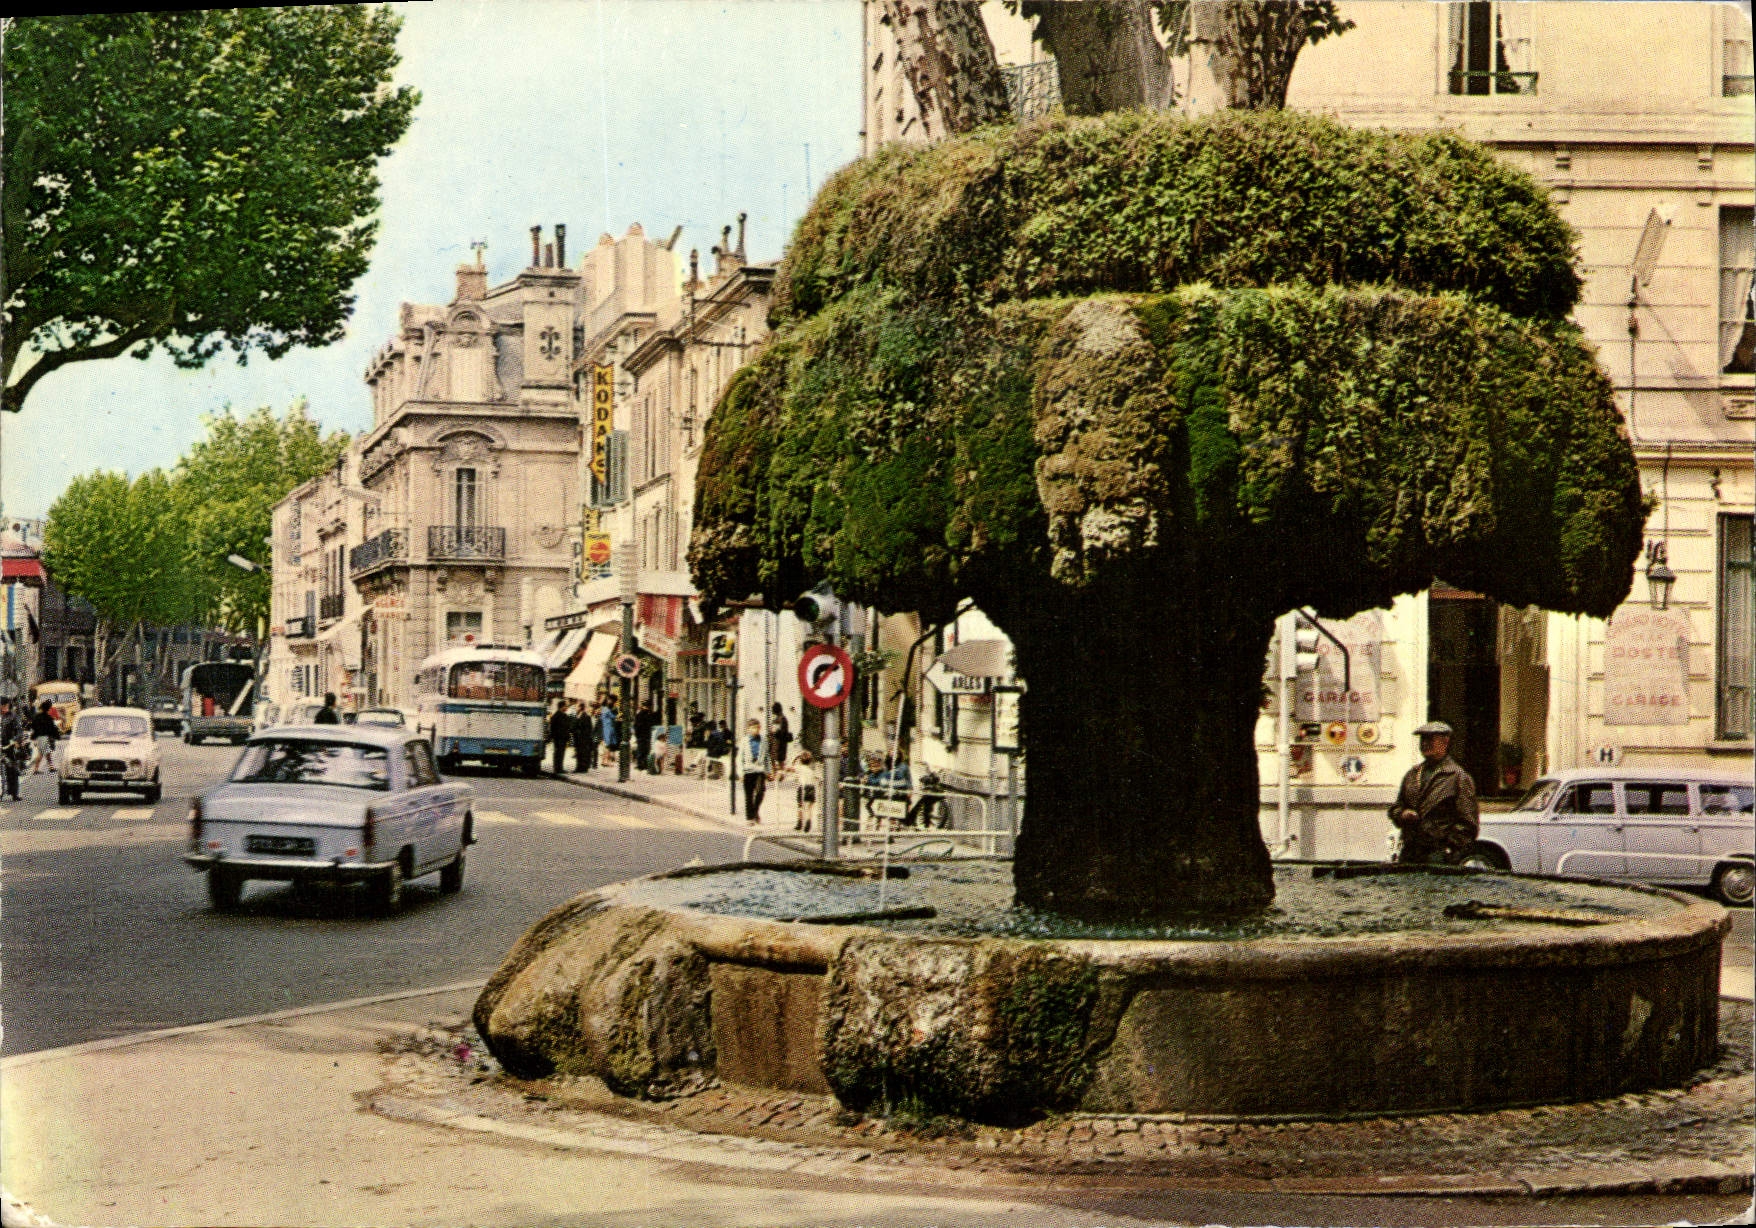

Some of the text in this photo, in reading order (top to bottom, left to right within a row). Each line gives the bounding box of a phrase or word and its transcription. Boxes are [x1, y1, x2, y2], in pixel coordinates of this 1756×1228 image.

[1612, 646, 1682, 660] POSTE
[952, 676, 982, 690] ARLES
[1303, 690, 1372, 703] GARAGE
[1611, 693, 1681, 707] GARAGE
[1600, 747, 1614, 762] H
